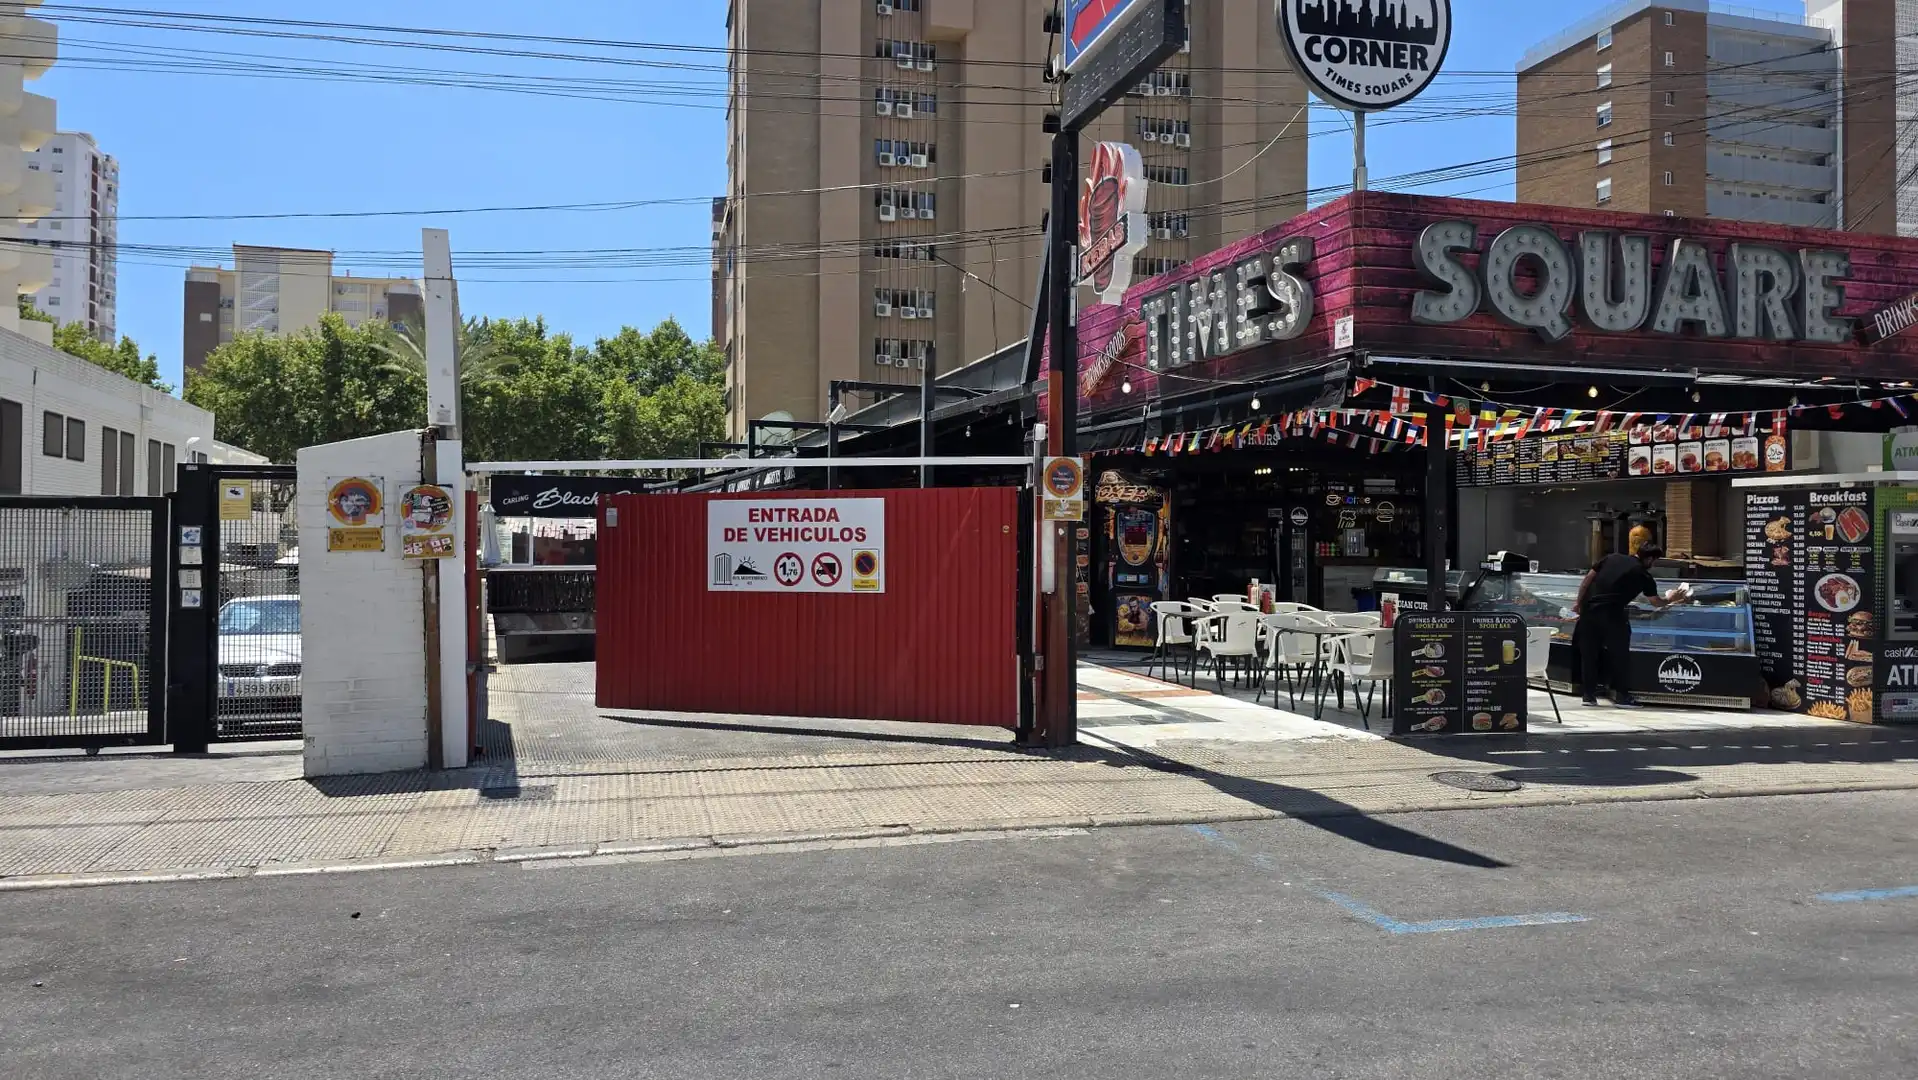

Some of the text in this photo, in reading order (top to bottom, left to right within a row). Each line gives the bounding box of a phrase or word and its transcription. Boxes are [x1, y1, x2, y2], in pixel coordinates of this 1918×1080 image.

[1304, 35, 1429, 71] CORNER
[1325, 67, 1413, 96] TIMES SQUARE
[1412, 219, 1854, 344] SQUARE
[1142, 236, 1315, 370] TIMES
[502, 494, 529, 506] CARLING
[1746, 494, 1780, 505] Pizzas
[1809, 491, 1868, 503] Breakfast
[749, 507, 840, 523] ENTRADA
[724, 526, 867, 542] DE VEHICULOS
[1413, 601, 1428, 610] CUR
